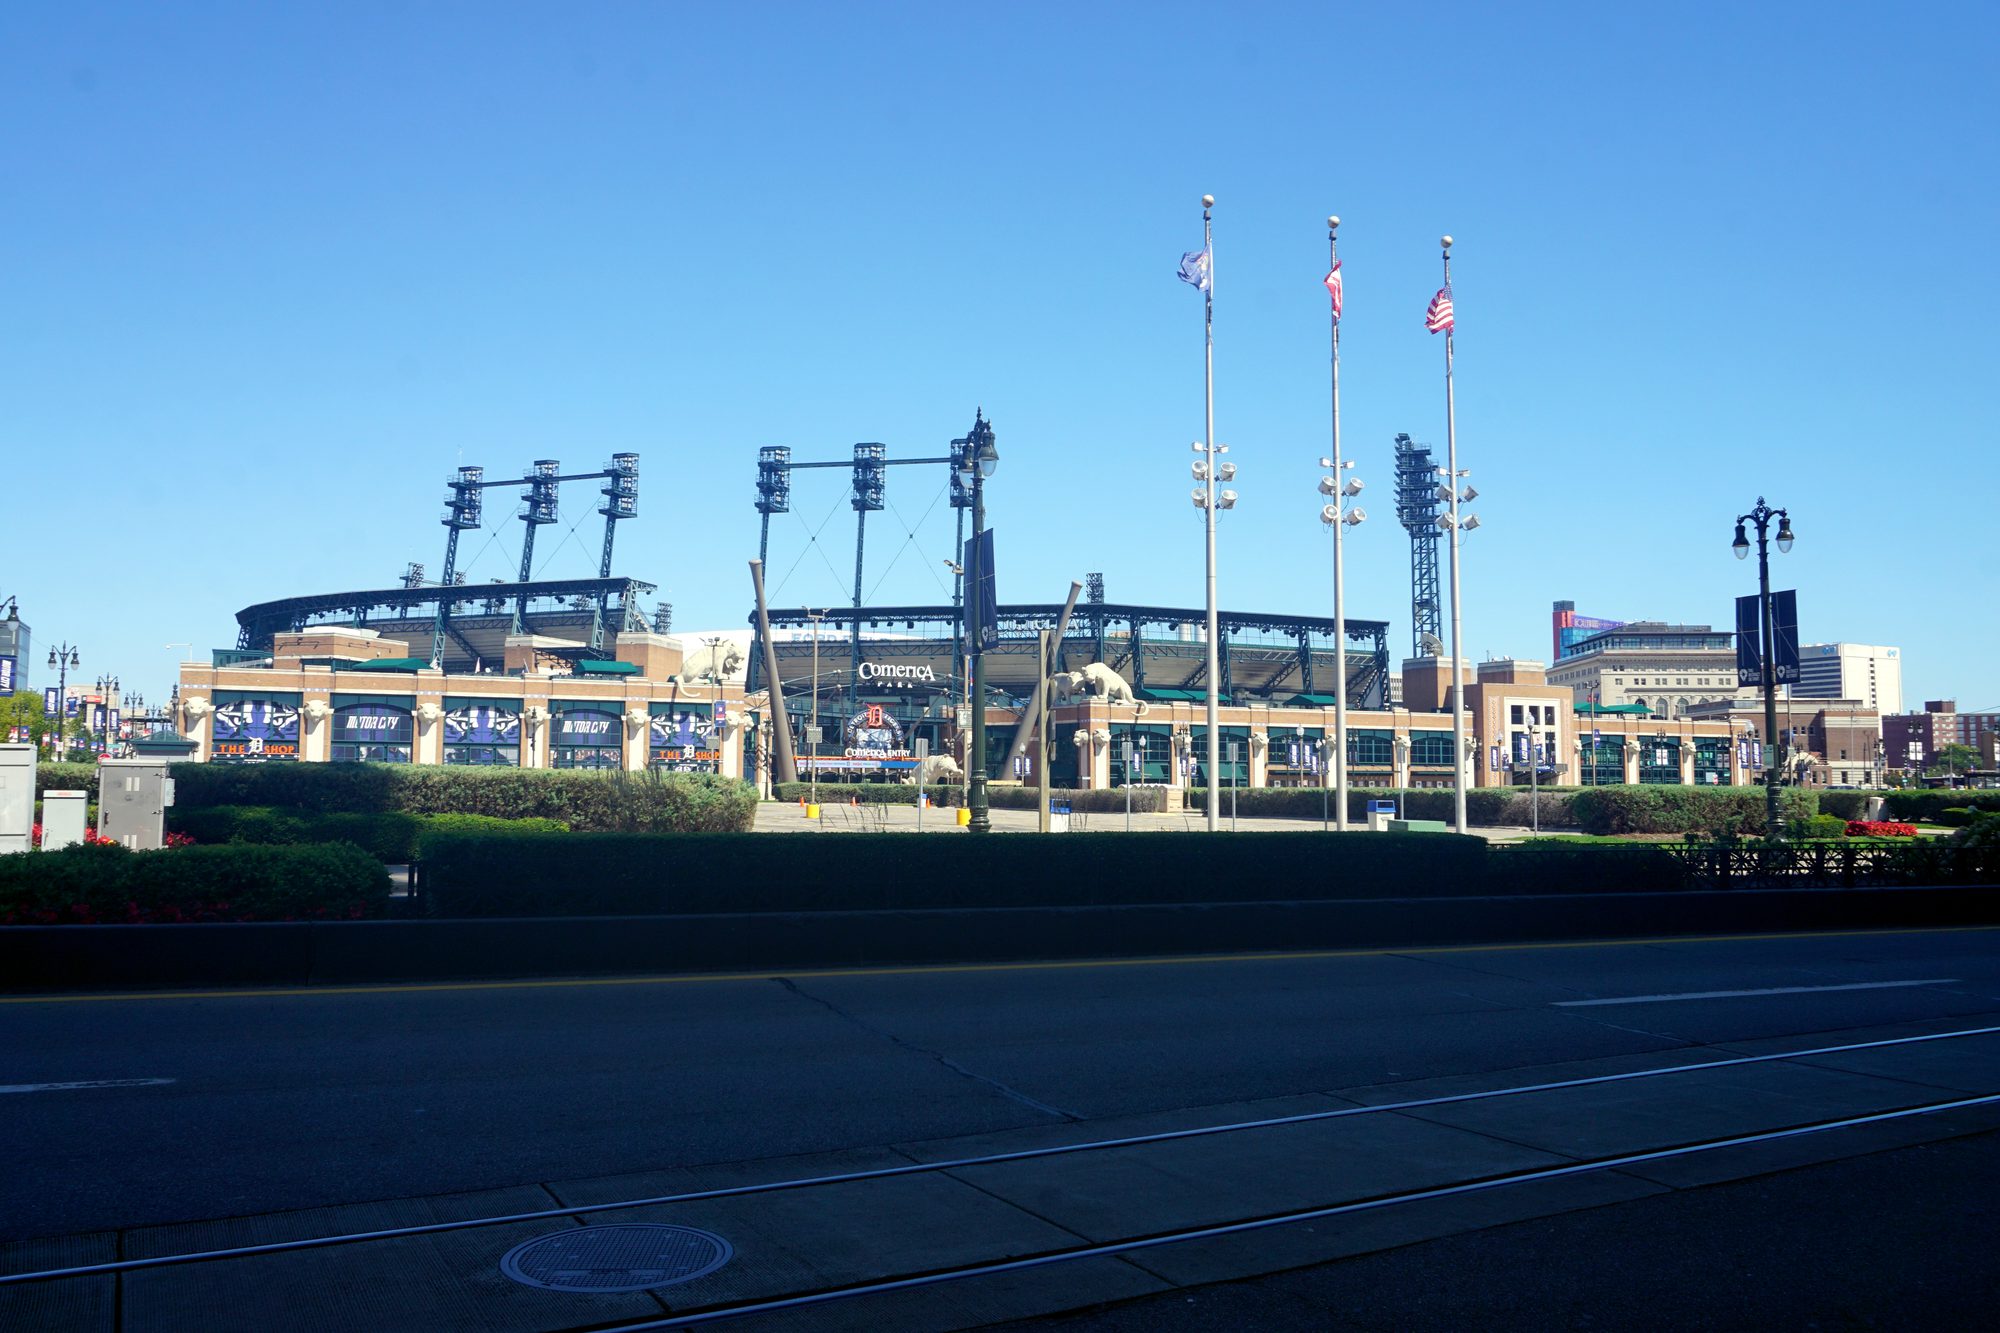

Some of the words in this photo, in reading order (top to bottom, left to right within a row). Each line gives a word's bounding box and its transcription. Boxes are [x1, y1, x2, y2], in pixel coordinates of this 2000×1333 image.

[220, 744, 245, 754] THE
[264, 745, 295, 754] SHOP
[887, 749, 911, 758] ENTRY
[695, 751, 720, 760] SHOP
